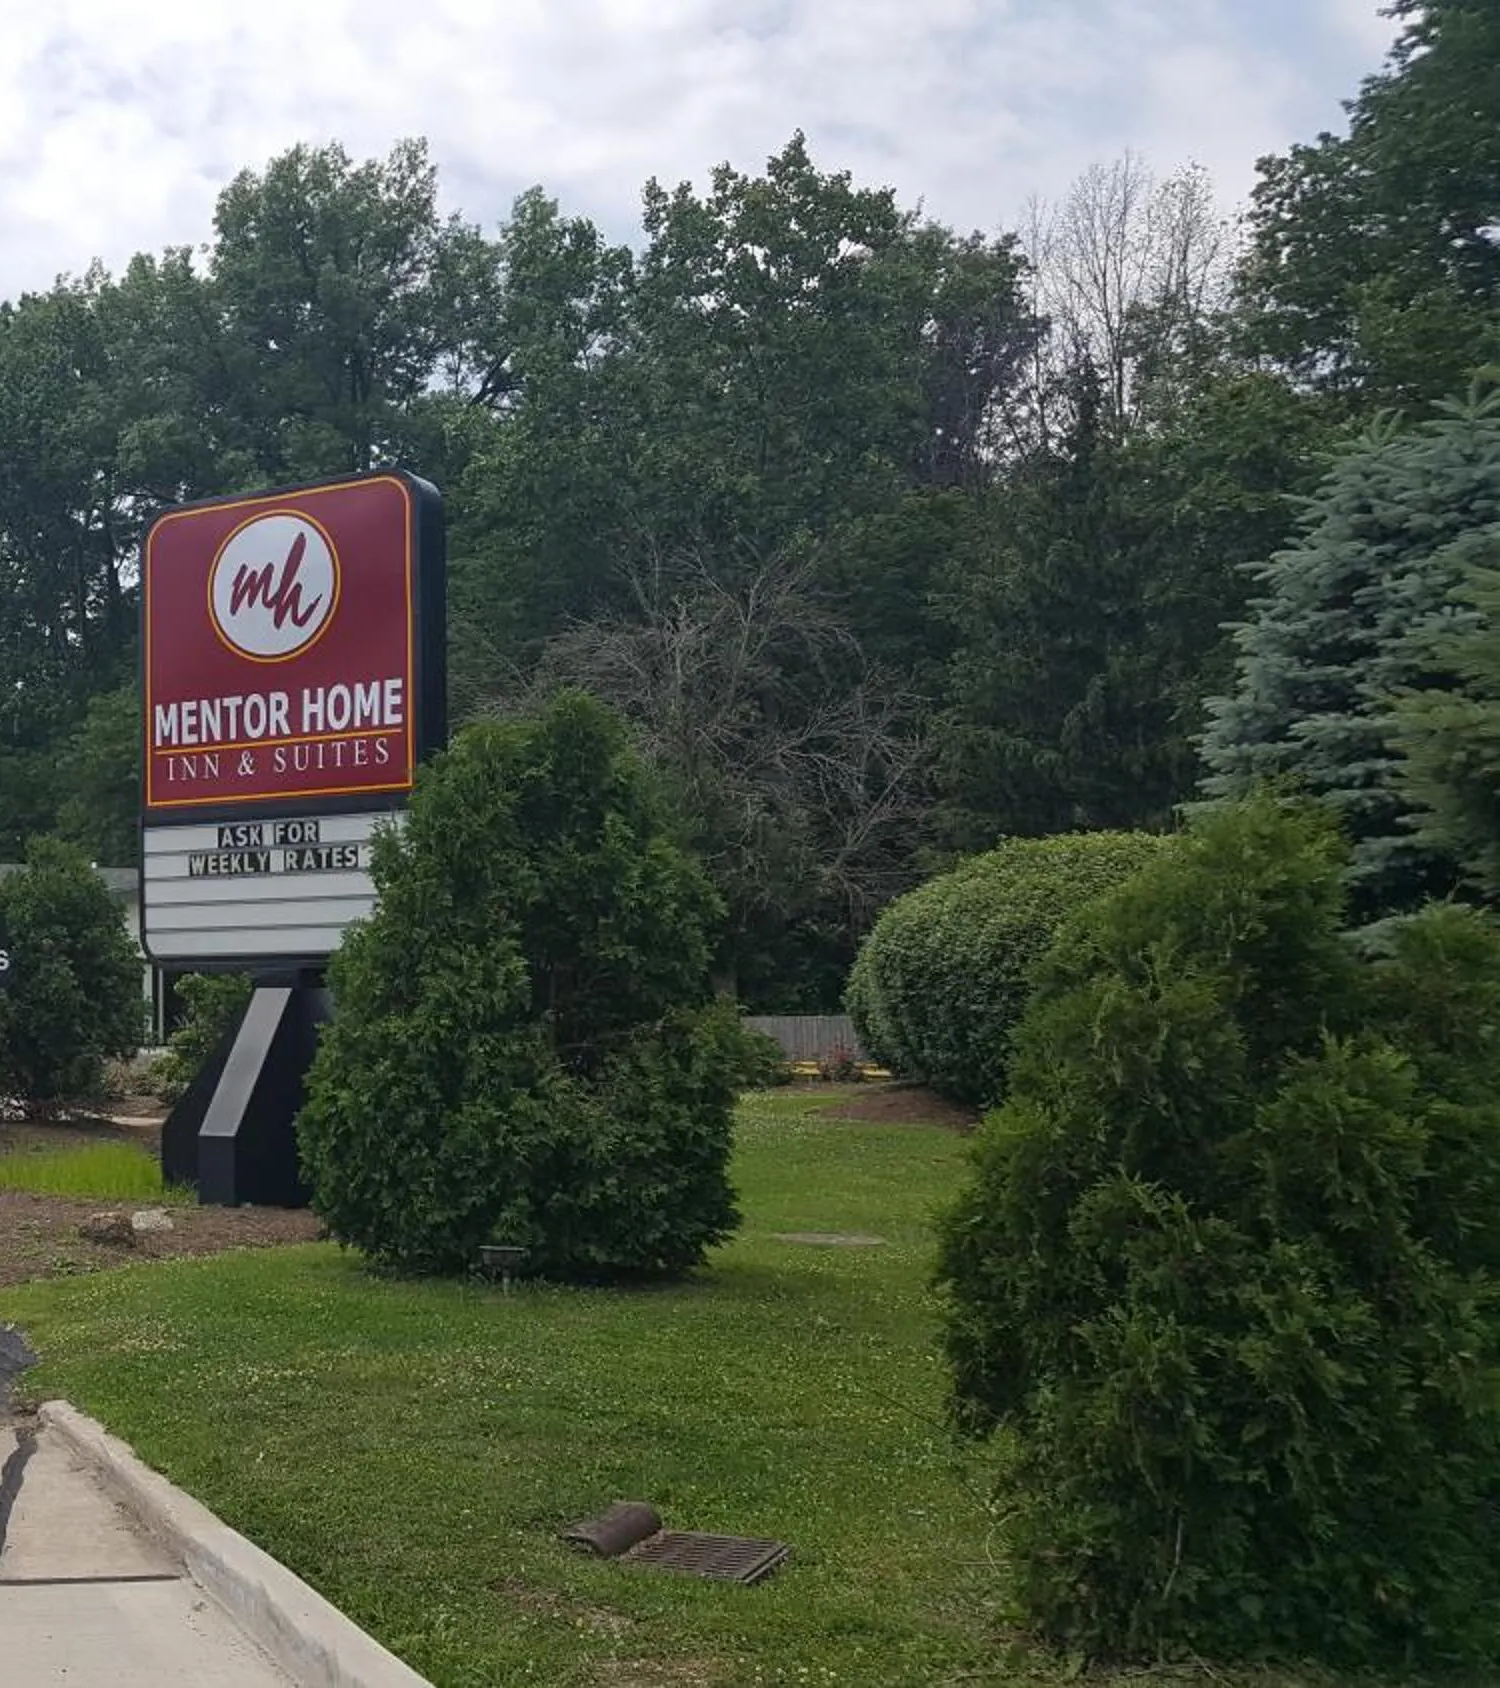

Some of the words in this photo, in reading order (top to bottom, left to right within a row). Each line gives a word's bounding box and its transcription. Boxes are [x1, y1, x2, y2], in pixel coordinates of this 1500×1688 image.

[230, 531, 322, 629] mh
[155, 691, 292, 747] MENTOR
[303, 678, 403, 733] HOME
[168, 754, 220, 781] INN
[237, 750, 256, 776] &
[273, 738, 390, 773] SUITES
[221, 826, 262, 848] ASK
[275, 822, 318, 844] FOR
[191, 851, 270, 876] WEEKLY
[286, 846, 357, 870] RATES
